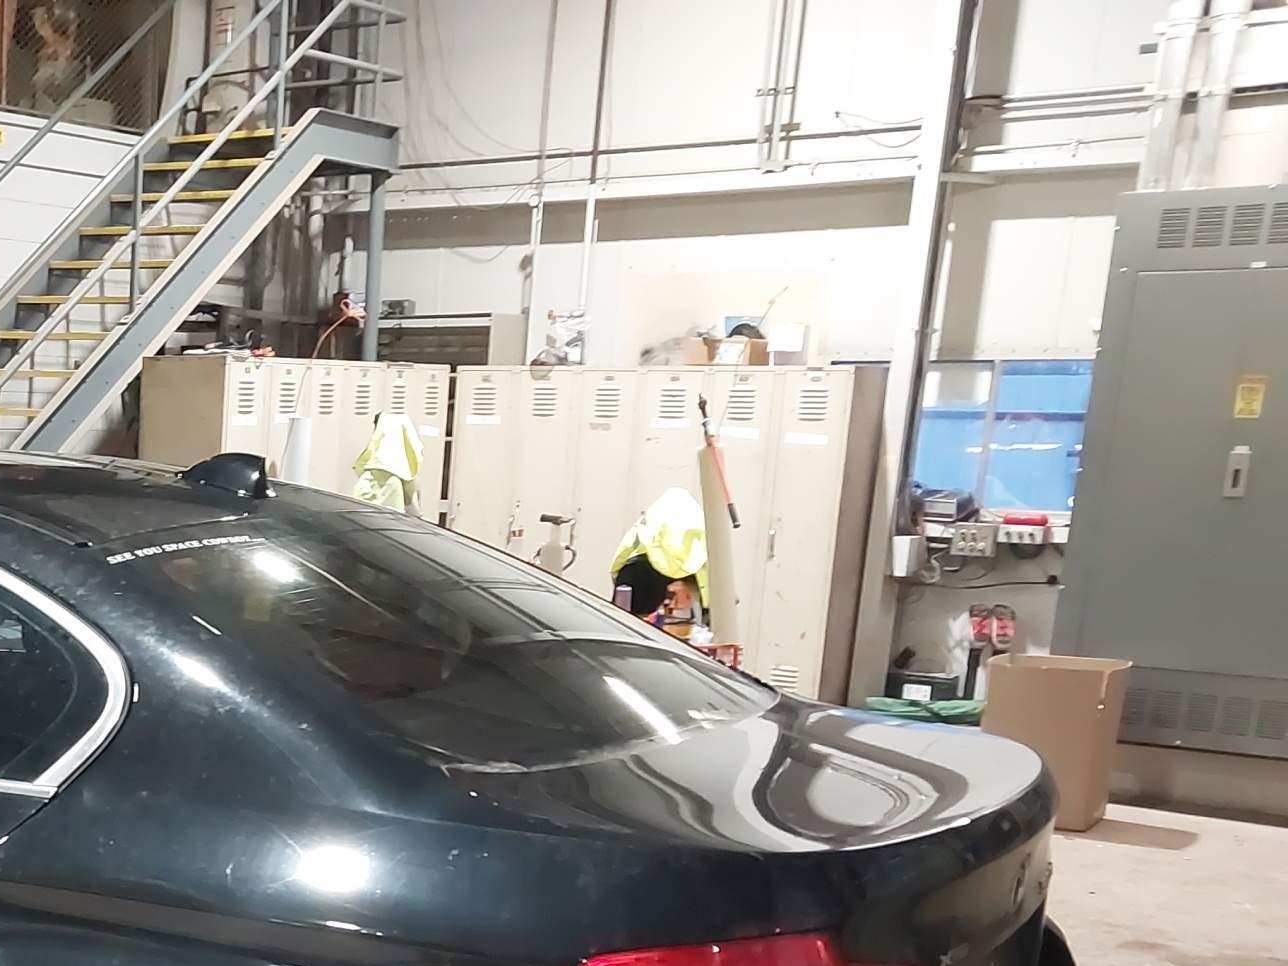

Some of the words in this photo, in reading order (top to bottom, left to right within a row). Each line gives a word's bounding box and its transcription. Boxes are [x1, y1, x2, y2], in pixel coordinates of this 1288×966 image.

[106, 552, 136, 565] SEE
[134, 545, 163, 557] YOU
[161, 540, 204, 552] SPACE
